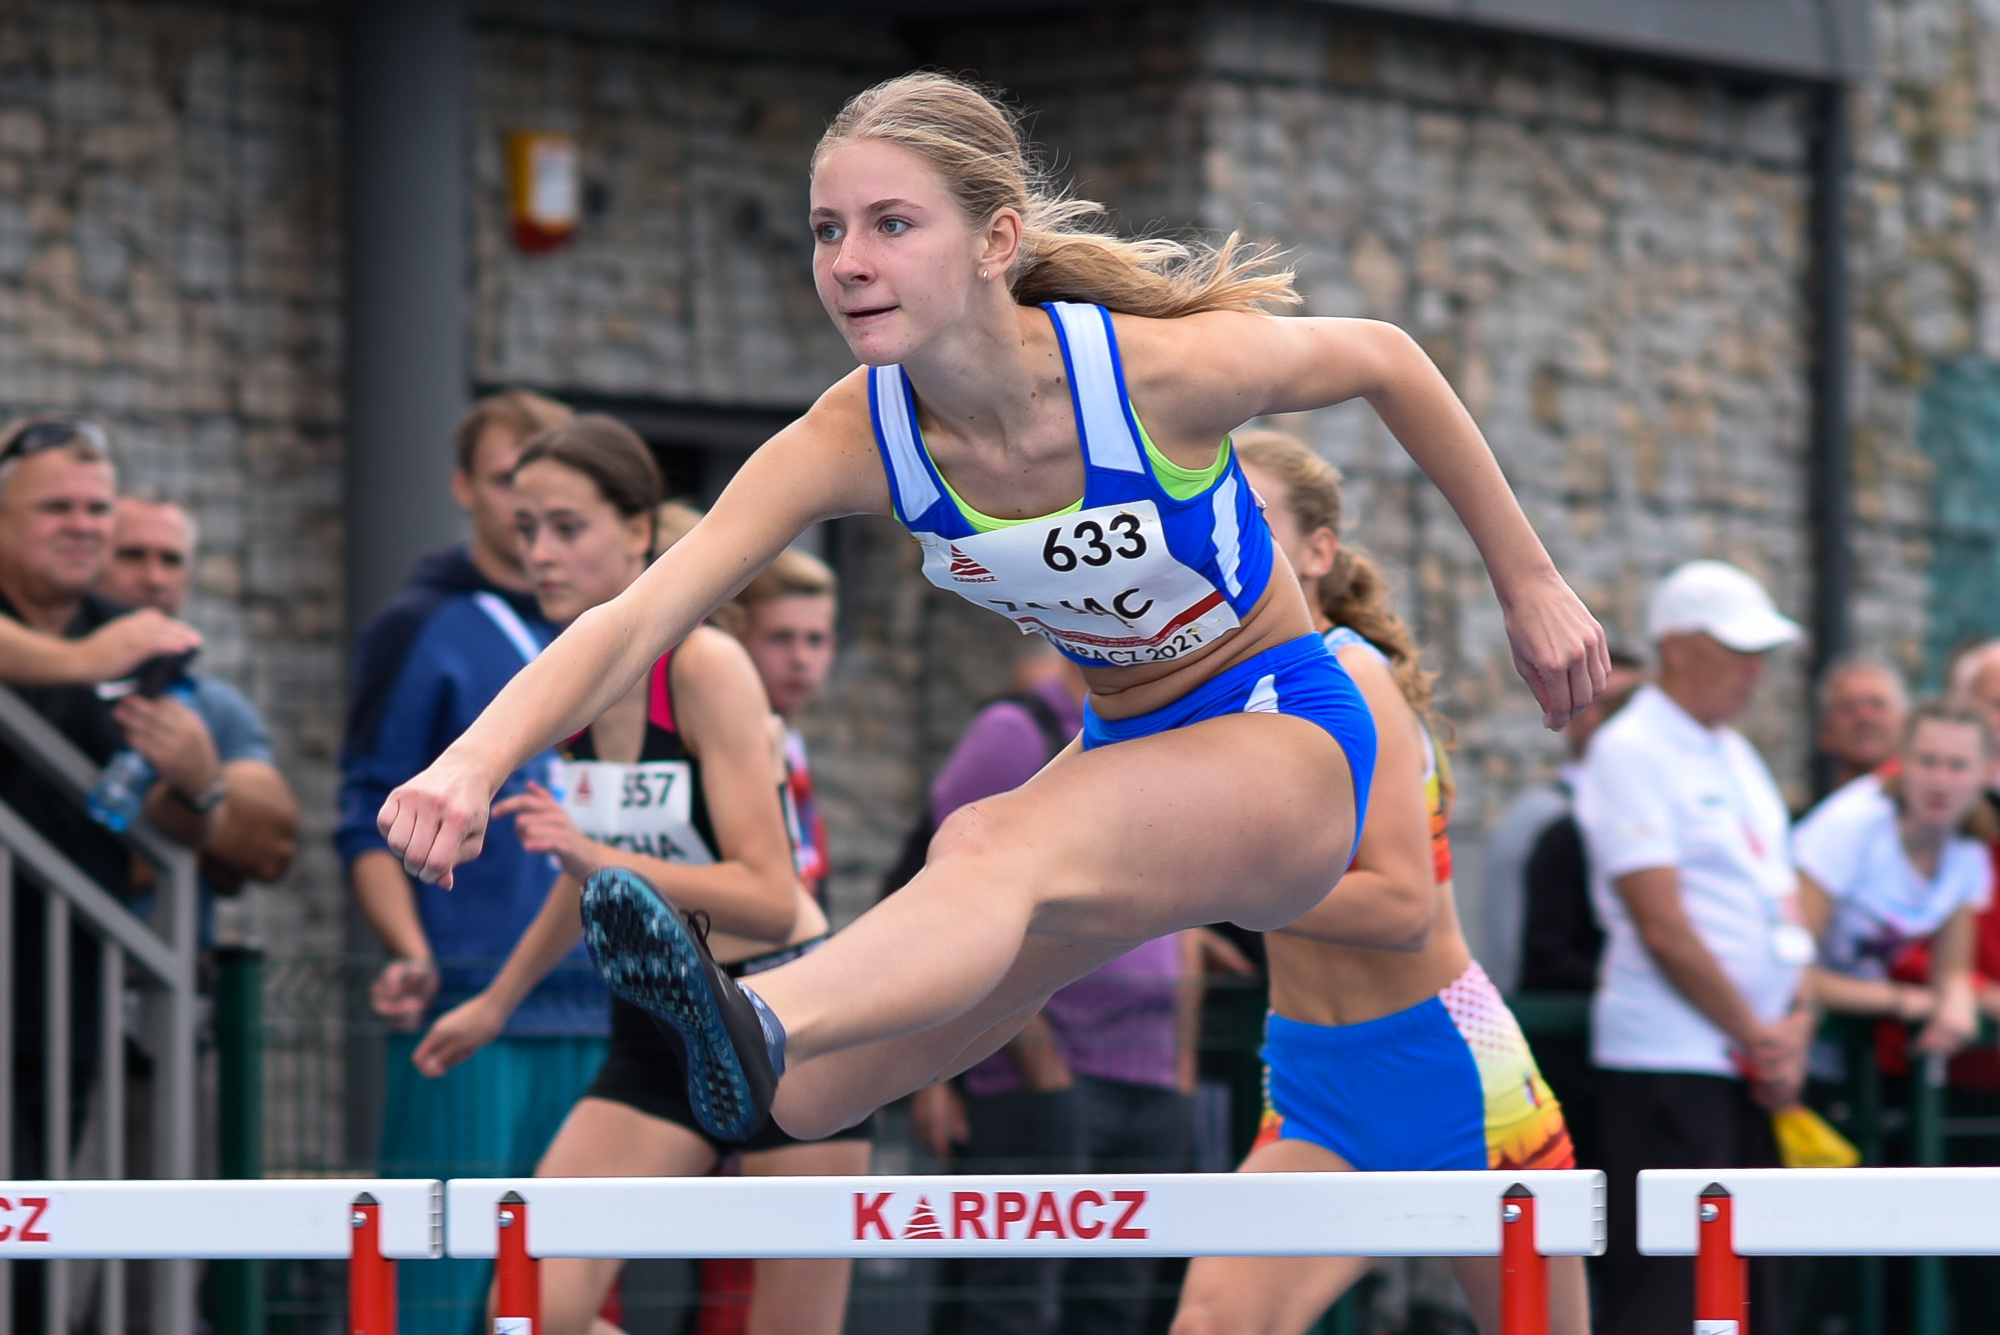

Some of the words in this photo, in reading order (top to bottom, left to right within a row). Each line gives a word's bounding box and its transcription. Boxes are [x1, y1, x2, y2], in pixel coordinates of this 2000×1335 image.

[1043, 514, 1148, 572] 633
[1145, 627, 1203, 661] 2021
[852, 1190, 1149, 1240] KARPACZ
